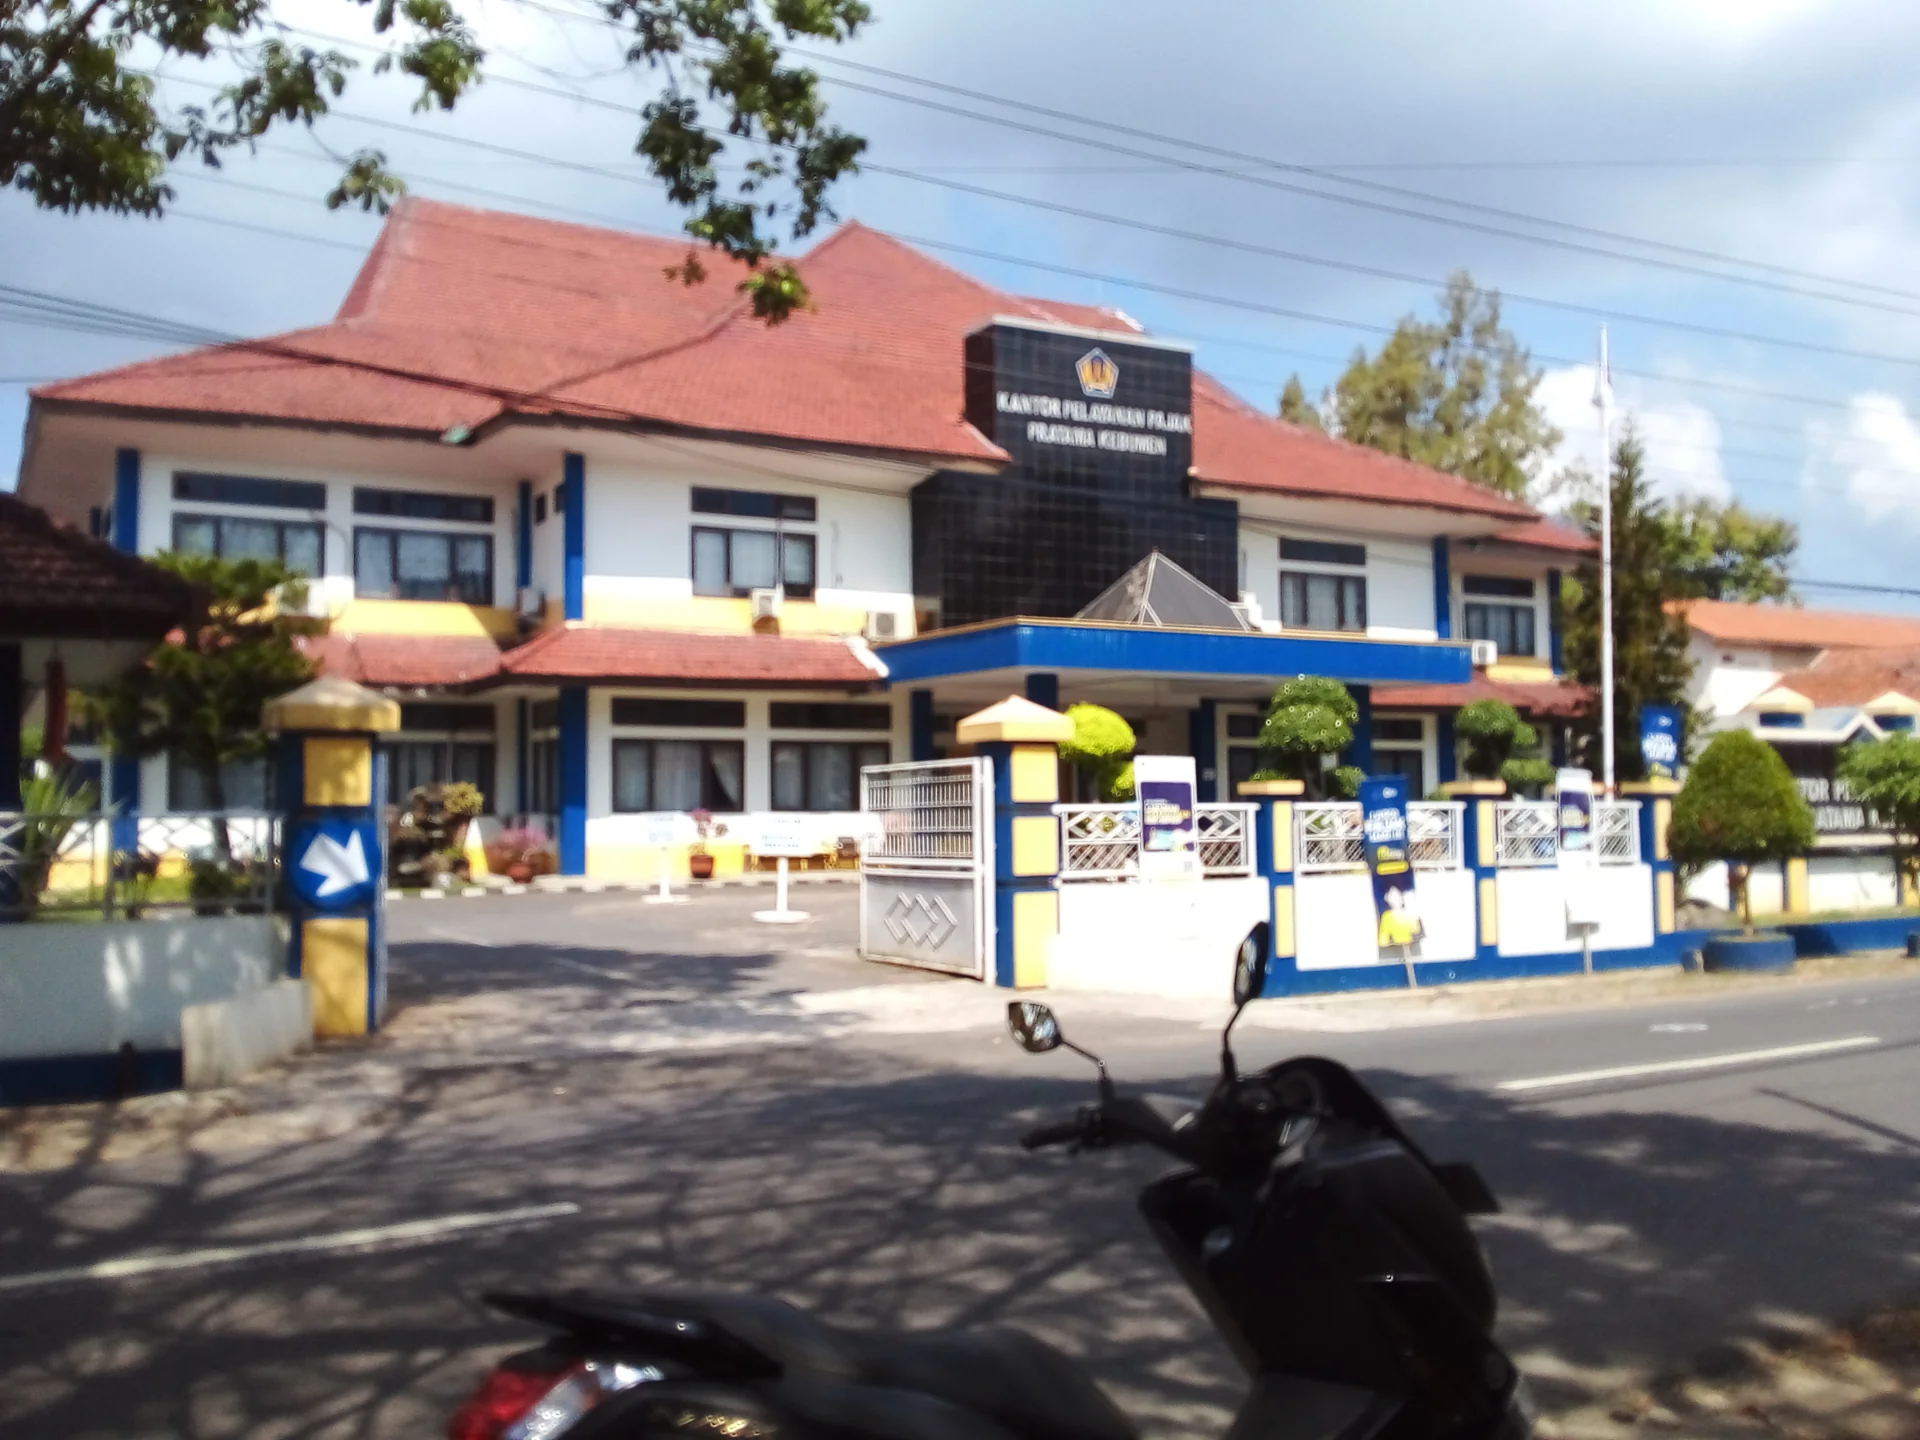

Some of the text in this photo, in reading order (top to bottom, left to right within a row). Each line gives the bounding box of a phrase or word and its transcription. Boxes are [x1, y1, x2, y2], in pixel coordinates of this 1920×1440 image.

[997, 392, 1192, 434] KANTOR PELAYANAN PAJAK
[1028, 422, 1166, 455] PRATAMA KEBUMEN
[1816, 807, 1864, 829] ATAMA
